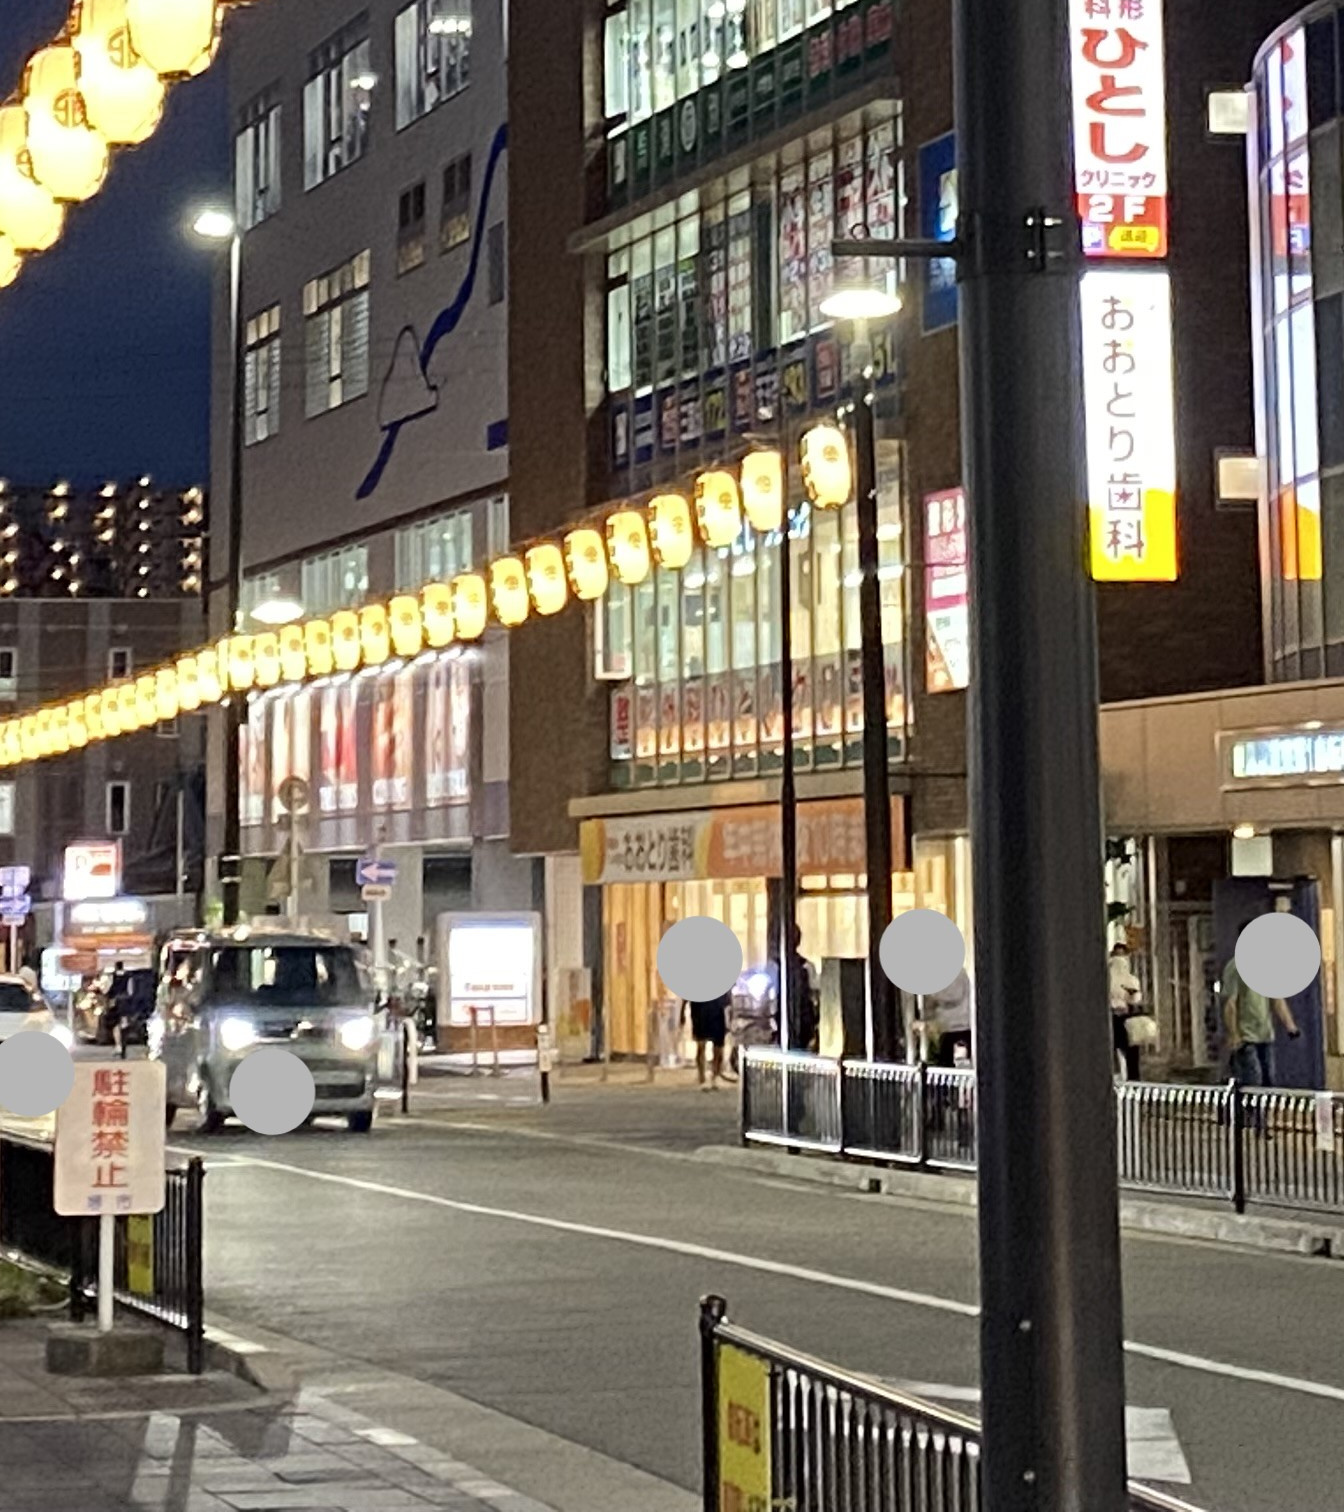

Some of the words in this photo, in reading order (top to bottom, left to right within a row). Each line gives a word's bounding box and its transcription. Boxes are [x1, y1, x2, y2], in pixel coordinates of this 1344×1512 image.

[1080, 27, 1150, 164] ひとし
[1080, 169, 1157, 188] クリニック
[1101, 296, 1145, 559] おおとり歯科
[90, 1068, 131, 1188] 駐輪禁止
